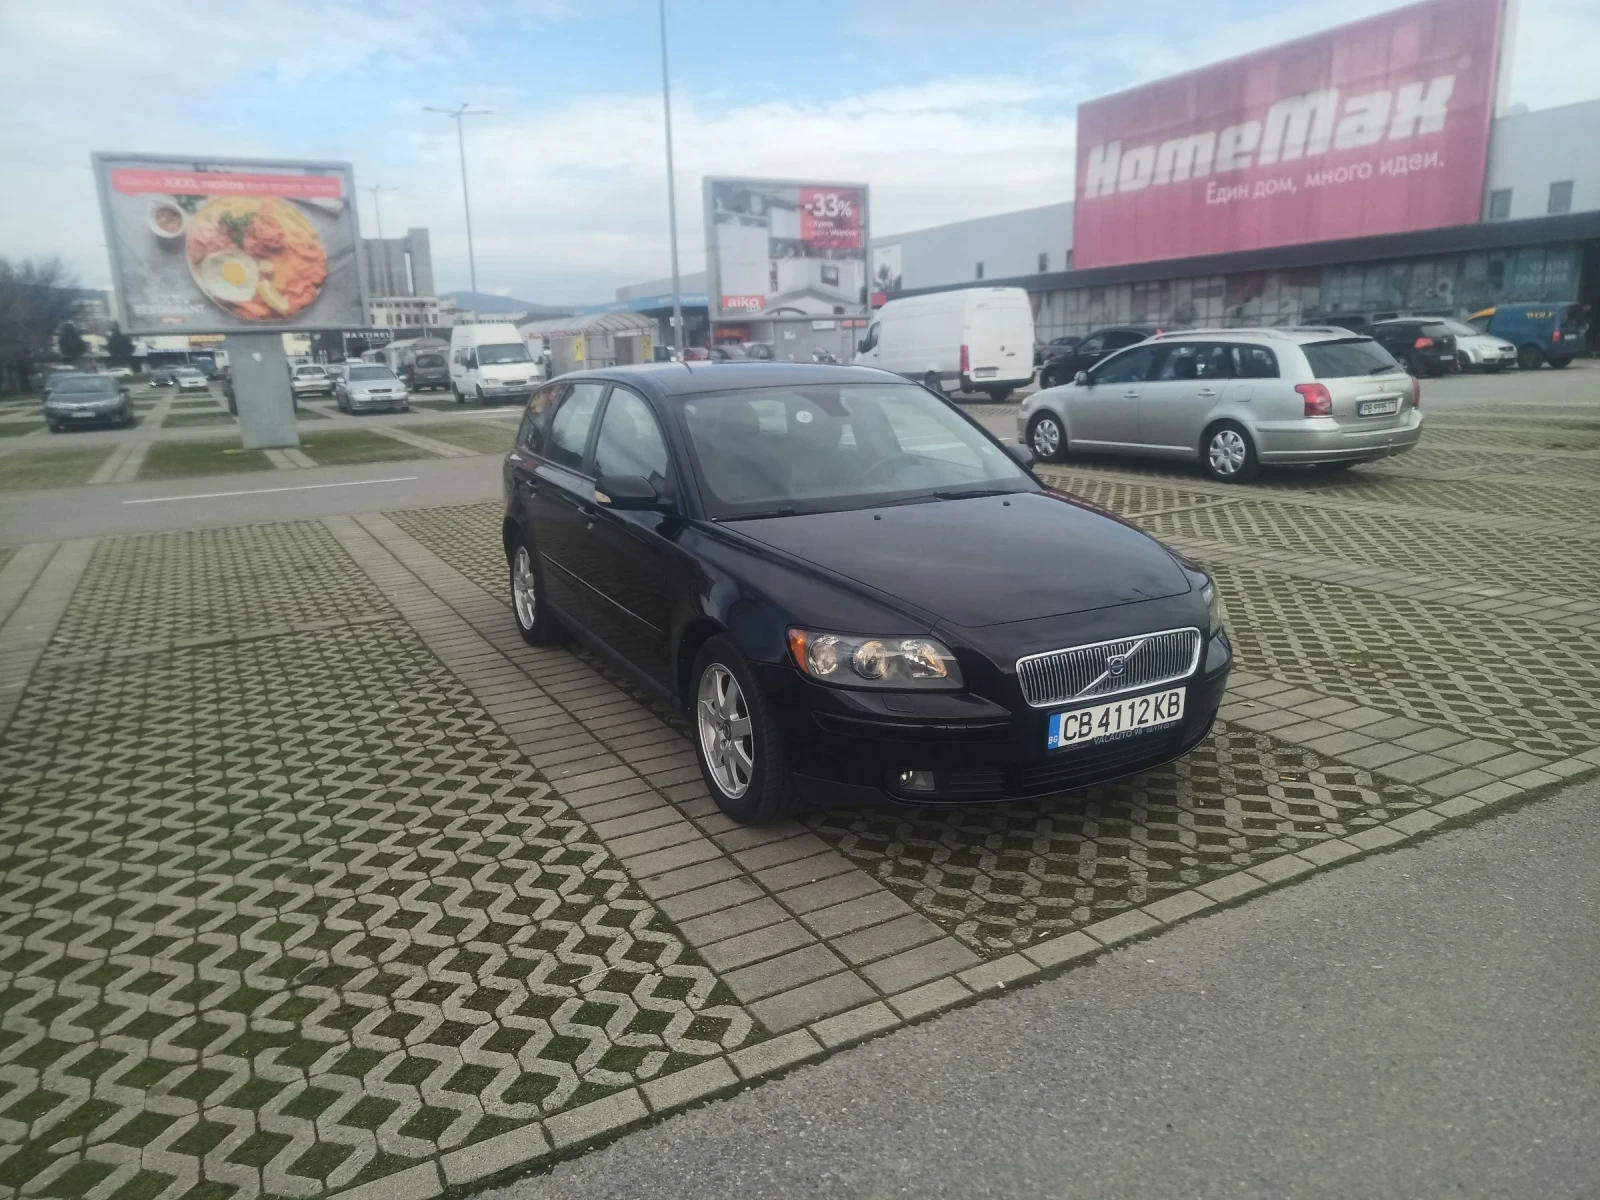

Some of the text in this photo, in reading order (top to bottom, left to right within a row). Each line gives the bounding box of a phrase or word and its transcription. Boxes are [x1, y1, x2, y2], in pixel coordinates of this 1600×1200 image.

[1085, 75, 1455, 199] HomeMax
[1206, 181, 1249, 205] Един
[1253, 175, 1298, 198] дом,
[1304, 161, 1372, 188] много
[805, 193, 852, 217] -33%
[1048, 735, 1058, 744] BG
[1093, 730, 1132, 745] VALAUTO
[1134, 727, 1143, 736] 98
